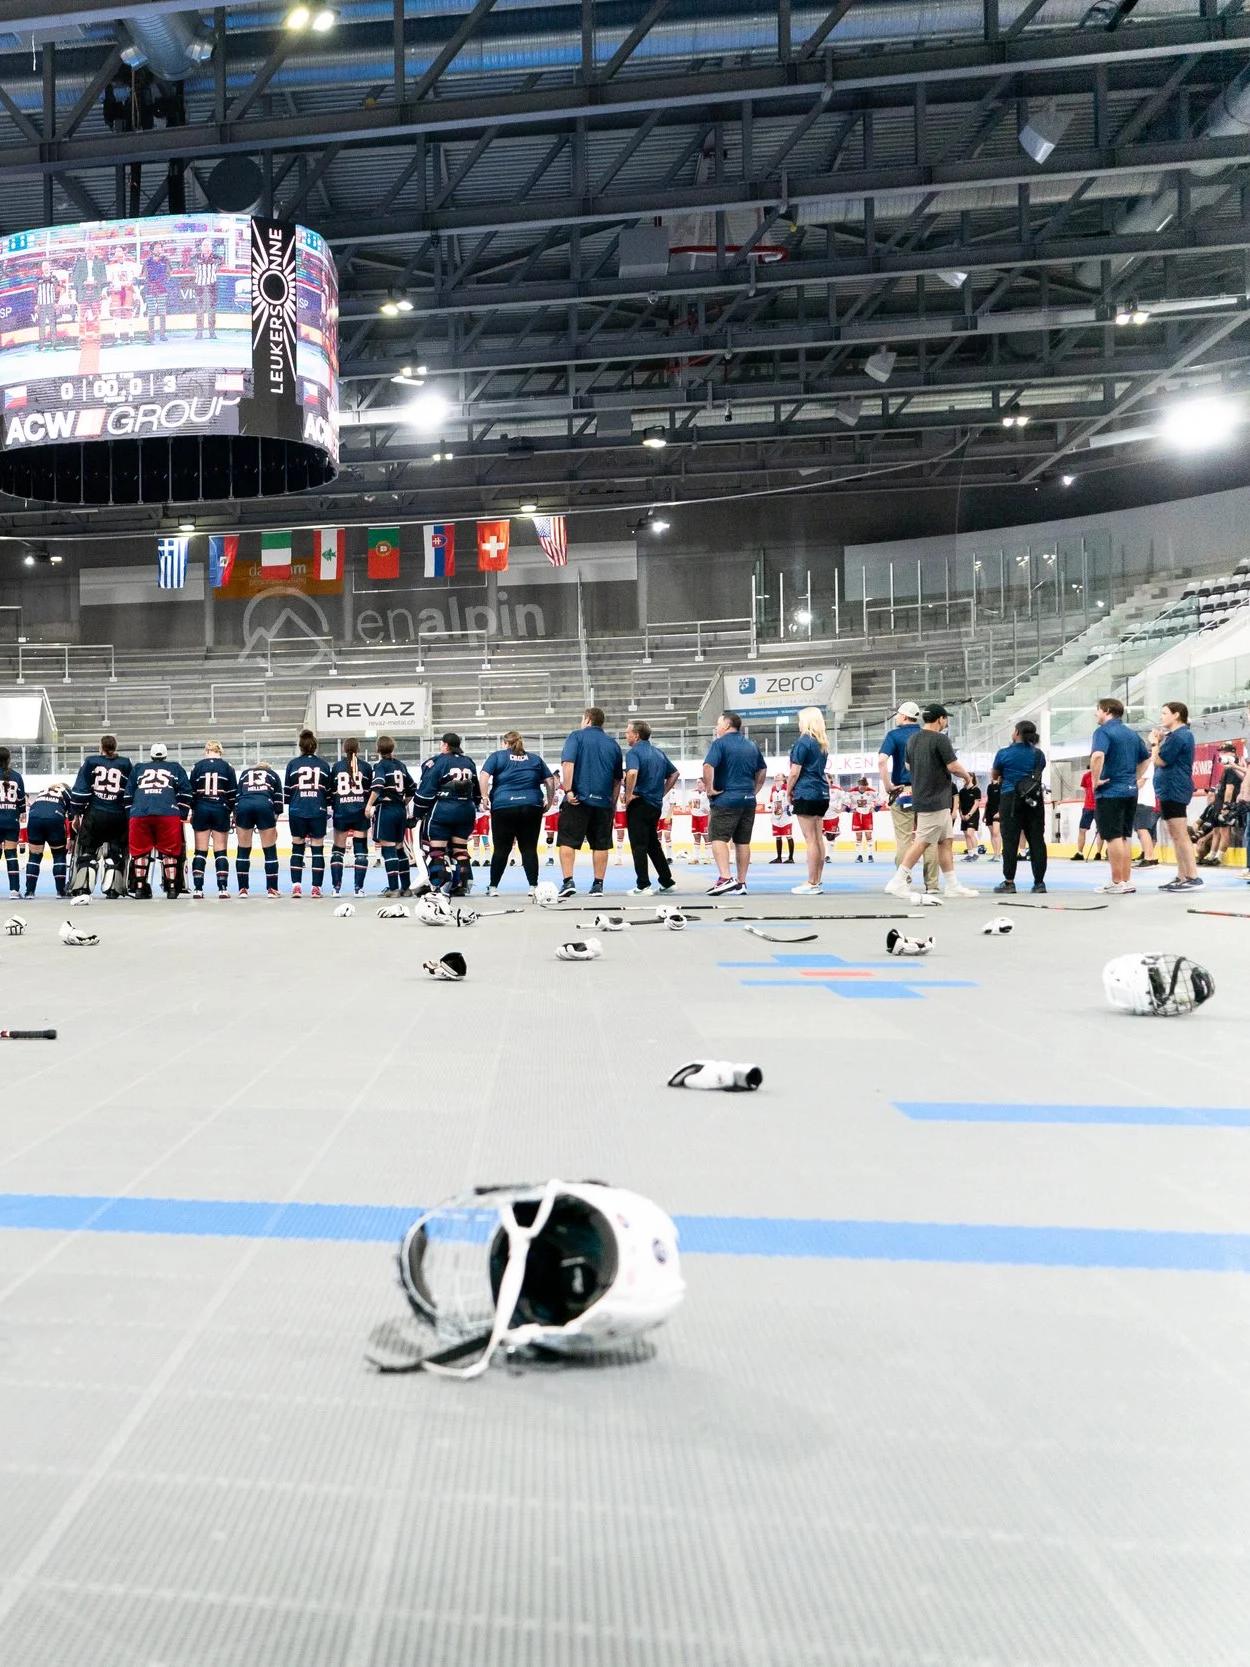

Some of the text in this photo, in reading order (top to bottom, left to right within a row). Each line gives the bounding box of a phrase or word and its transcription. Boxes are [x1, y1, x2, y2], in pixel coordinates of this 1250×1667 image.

[163, 375, 176, 392] 3
[6, 411, 75, 444] ACW
[327, 701, 415, 718] REVAZ
[94, 766, 121, 793] 29
[138, 769, 171, 789] 25
[204, 772, 218, 796] 11
[248, 770, 267, 786] 13
[298, 766, 320, 790] 21
